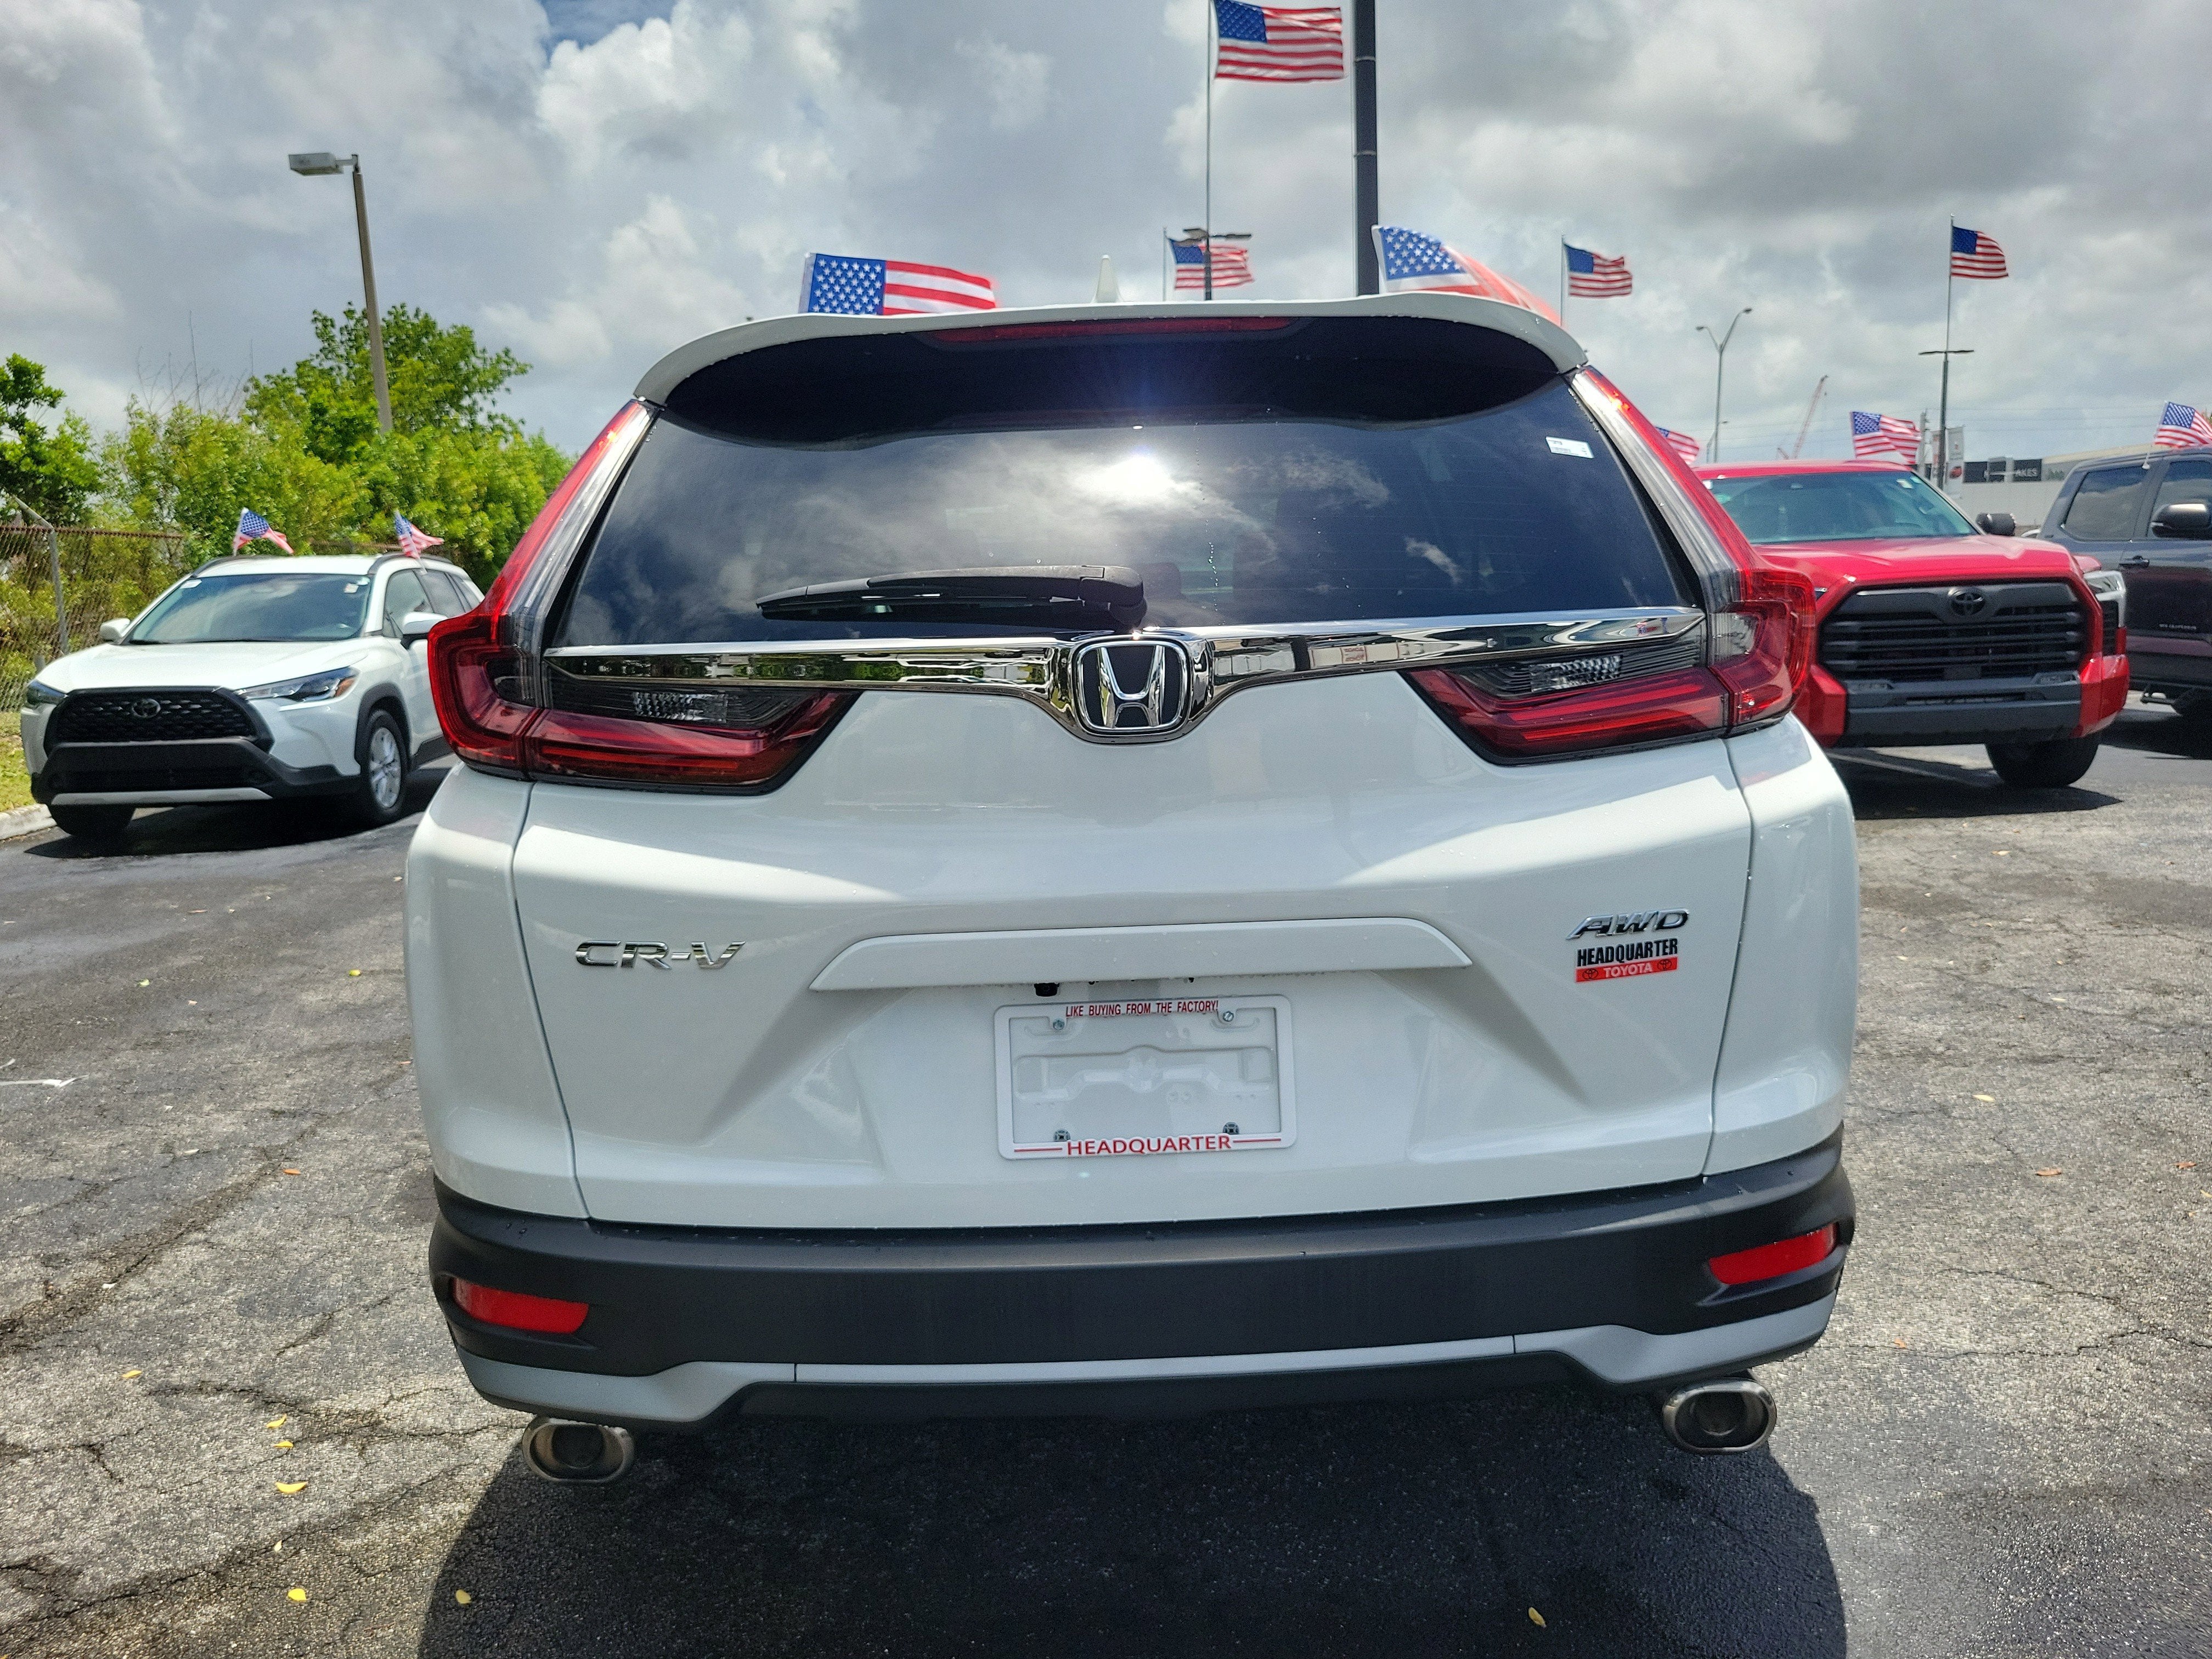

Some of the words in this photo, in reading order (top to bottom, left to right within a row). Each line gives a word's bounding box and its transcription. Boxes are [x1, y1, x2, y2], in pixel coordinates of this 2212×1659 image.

[1566, 908, 1690, 940] AWD
[575, 940, 746, 970] CR-V
[1577, 938, 1678, 967] HEADQUARTER
[1603, 962, 1653, 978] TOYOTA
[1065, 1005, 1084, 1018] LIKE
[1088, 1003, 1121, 1017] BUYING
[1126, 1002, 1151, 1015] FROM
[1155, 1002, 1172, 1014] THE
[1177, 1000, 1219, 1013] FACTORY!
[1067, 1135, 1231, 1155] HEADQUARTER
